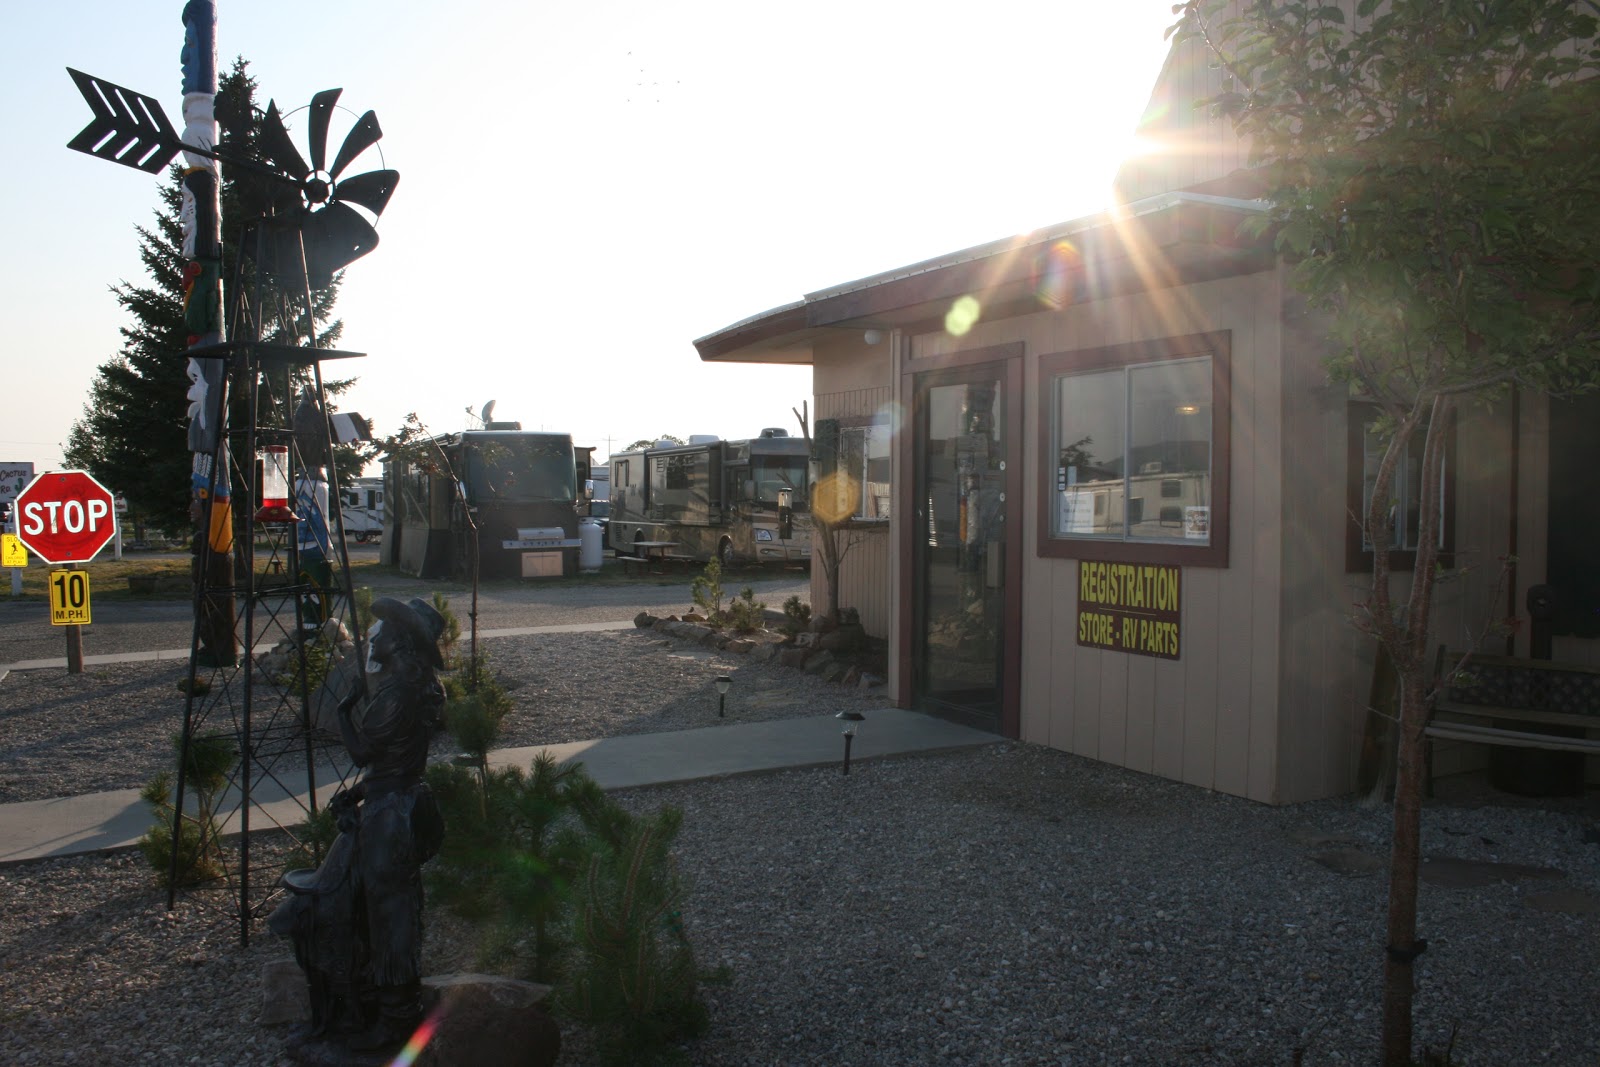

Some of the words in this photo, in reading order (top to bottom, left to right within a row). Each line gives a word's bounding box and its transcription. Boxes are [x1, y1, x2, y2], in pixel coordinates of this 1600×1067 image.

[0, 470, 27, 481] CACTUS
[24, 499, 108, 536] STOP
[54, 575, 85, 608] 10
[1081, 562, 1178, 612] REGISTRATION
[56, 610, 86, 619] M.P.H.
[1080, 612, 1114, 645] STORE
[1123, 617, 1138, 648] RV
[1141, 620, 1178, 655] PARTS
